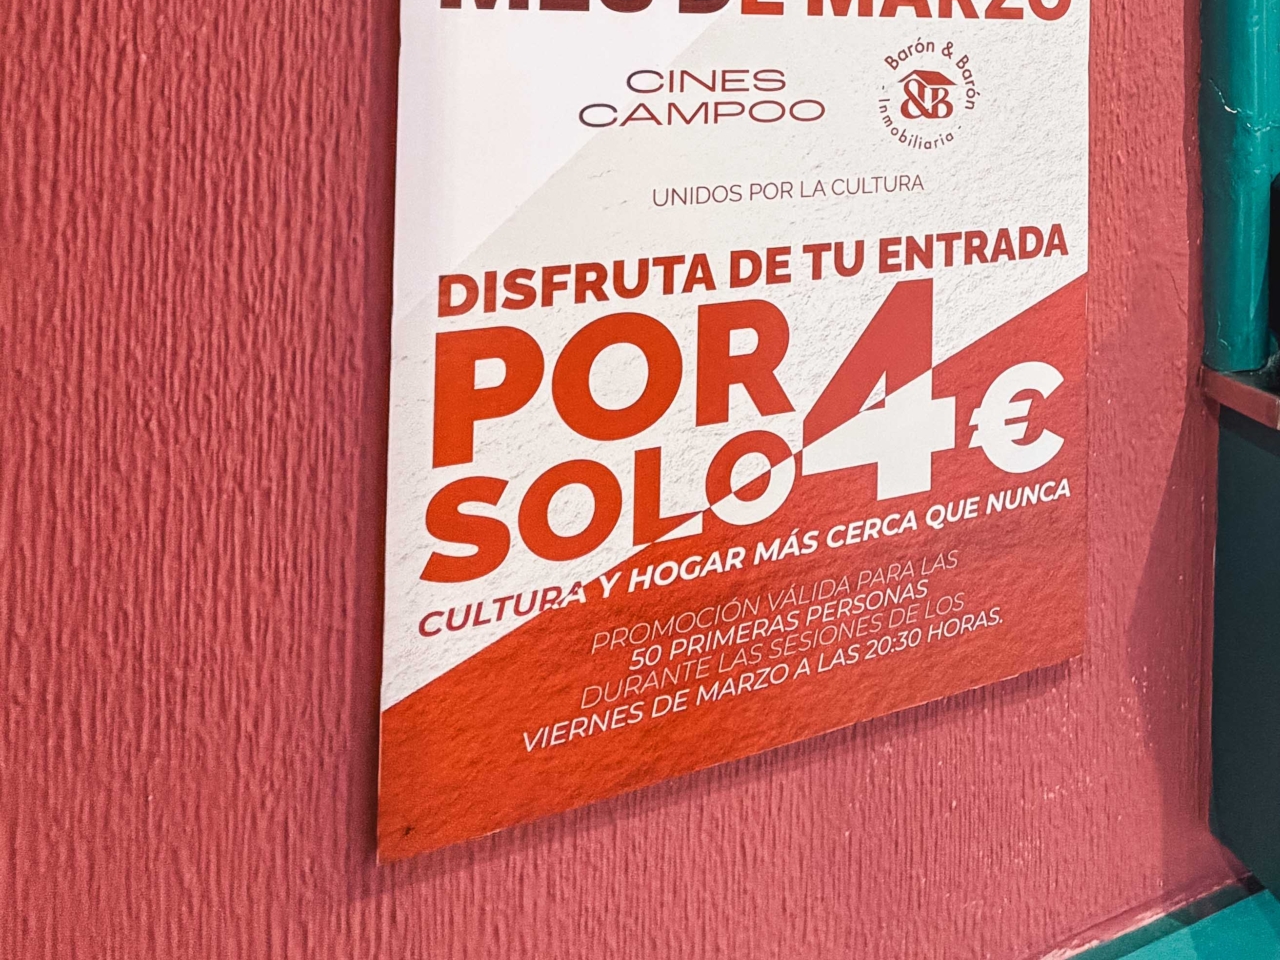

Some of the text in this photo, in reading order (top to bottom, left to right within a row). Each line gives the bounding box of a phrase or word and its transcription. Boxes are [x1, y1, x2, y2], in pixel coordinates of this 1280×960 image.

[578, 99, 826, 128] CAMPOO
[626, 69, 786, 93] CINES
[883, 36, 981, 111] Barón & Barón
[878, 97, 955, 150] Inmobiliaria
[652, 174, 925, 207] UNIDOS POR LA CULTURA
[438, 223, 1069, 318] DISFRUTA DE TU ENTRADA
[432, 298, 796, 469] POR
[419, 429, 797, 584] SOLO
[418, 478, 1071, 638] CULTURA Y HOGAR MÁS CERCA QUE NUNCA
[591, 549, 958, 655] PROMOCIÓN VÁLIDA PARA LAS
[580, 592, 965, 710] DURANTE LAS SESIONES DE LOS
[629, 579, 929, 671] 50 PRIMERAS PERSONAS
[522, 606, 1004, 753] VIERNES DE MARZO A LAS 20:30 HORAS.
